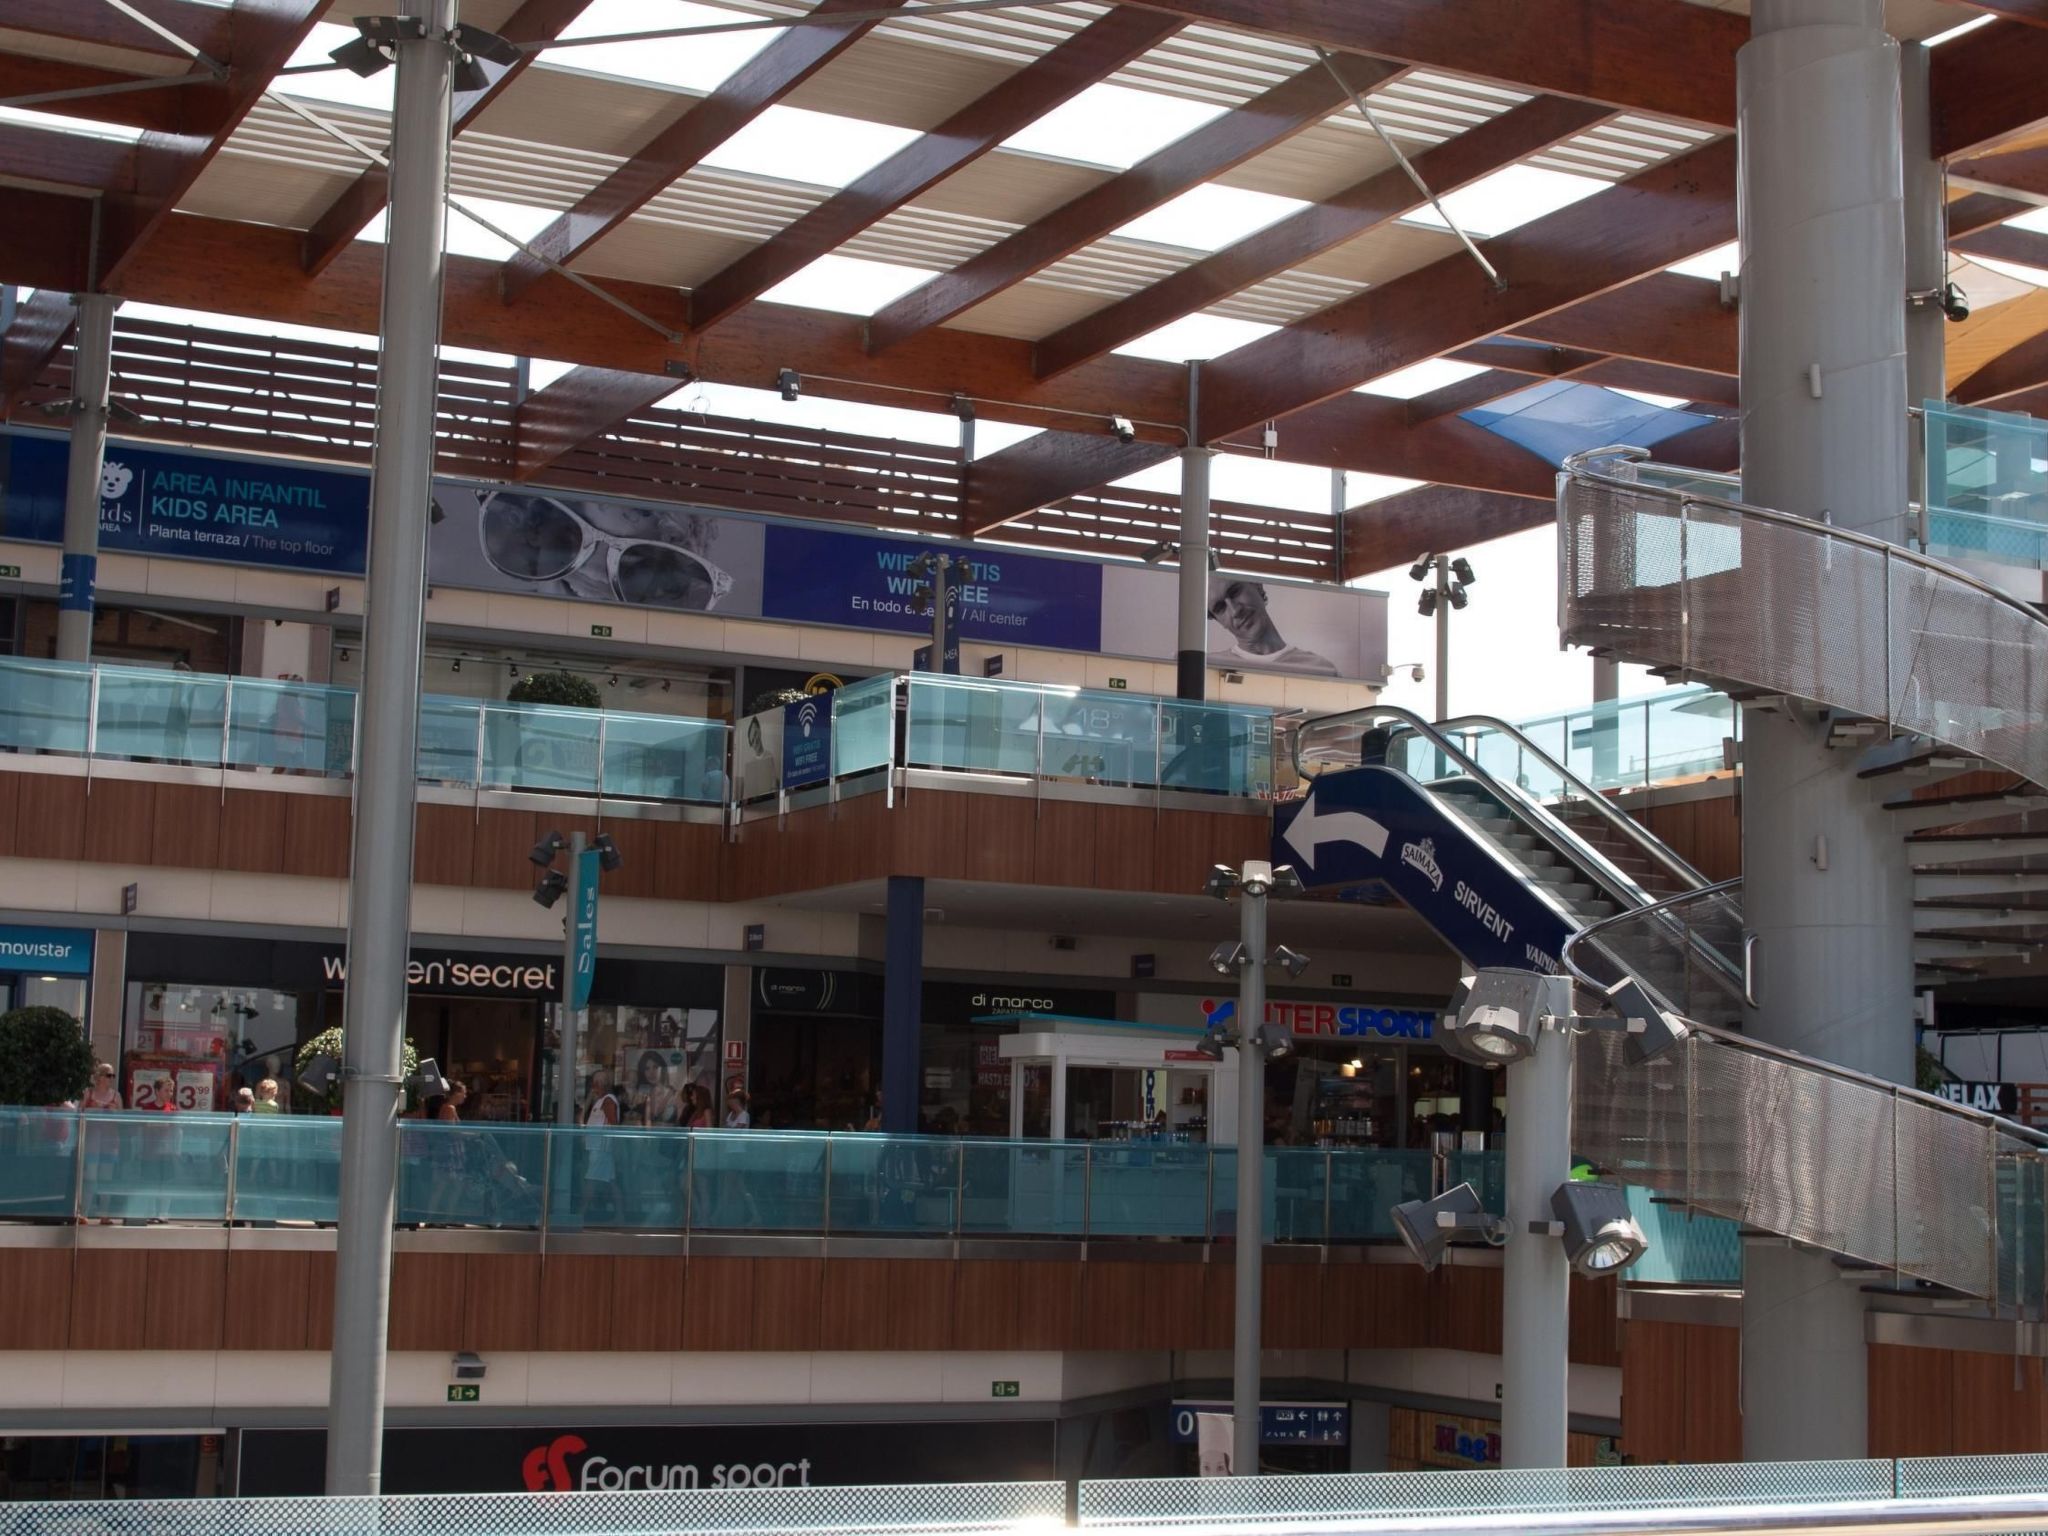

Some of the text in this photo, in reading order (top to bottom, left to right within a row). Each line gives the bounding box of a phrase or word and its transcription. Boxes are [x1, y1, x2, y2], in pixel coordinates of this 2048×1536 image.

[152, 470, 327, 509] AREA INFANTIL
[101, 501, 132, 523] ids
[151, 495, 280, 529] KIDS AREA
[150, 523, 191, 541] Planta
[194, 529, 241, 547] terraza
[251, 534, 278, 551] The
[280, 539, 302, 554] top
[304, 541, 335, 556] floor
[851, 596, 870, 610] En
[873, 599, 902, 614] todo
[969, 610, 986, 623] All
[988, 612, 1028, 627] center
[1403, 845, 1443, 885] SAIMAZA
[1454, 880, 1515, 944] SIRVENT
[0, 942, 72, 958] movistar
[322, 955, 556, 990] wen'secret
[972, 993, 1054, 1010] di marco
[1237, 1000, 1438, 1039] TERSPORT
[1176, 1410, 1194, 1436] 0
[711, 1458, 812, 1488] sport
